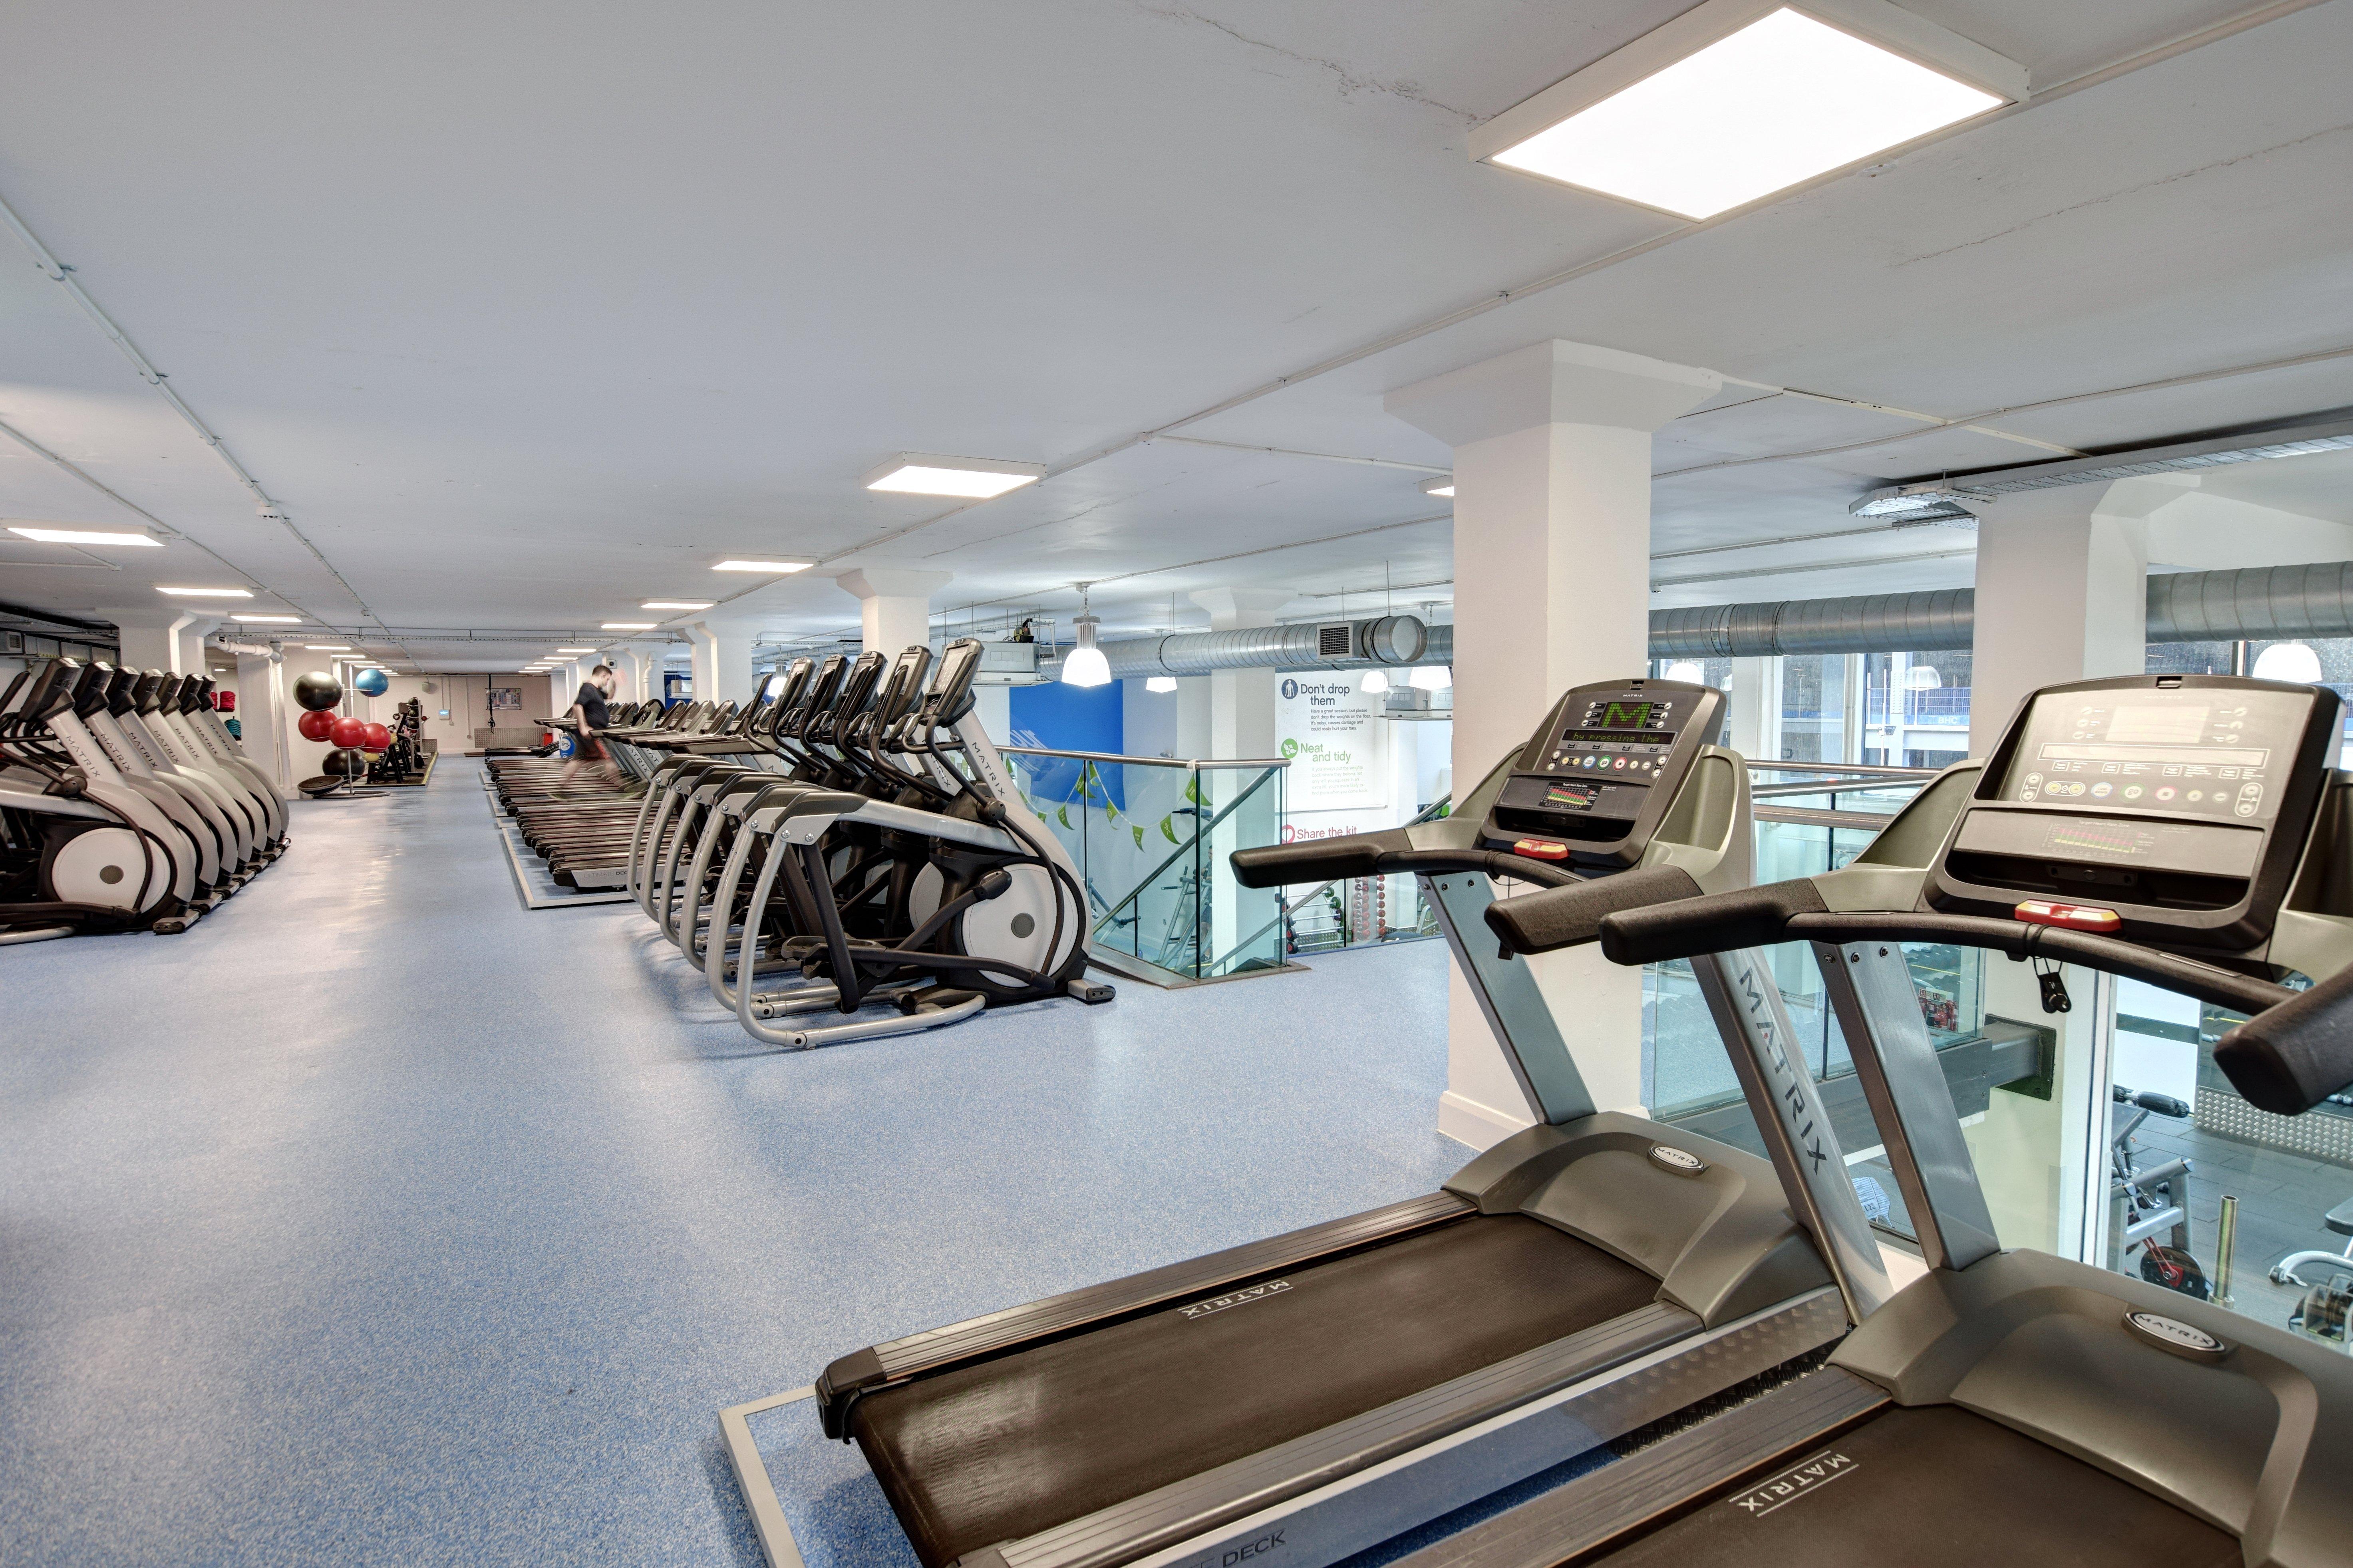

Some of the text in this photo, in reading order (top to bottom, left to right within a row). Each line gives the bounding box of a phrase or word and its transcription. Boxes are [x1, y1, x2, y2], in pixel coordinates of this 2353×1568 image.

[1301, 683, 1350, 697] Don't drop
[1310, 695, 1335, 705] them
[101, 733, 132, 771] MATRIX
[129, 732, 158, 767] MATRIX
[153, 730, 180, 763] MATRIX
[175, 728, 200, 758] MATRIX
[195, 726, 218, 754] MATRIX
[1301, 743, 1323, 753] Neat
[1572, 732, 1585, 740] by
[1641, 734, 1659, 743] the
[66, 736, 101, 777] MATRIX
[972, 742, 1005, 796] MATRIX
[1312, 750, 1351, 764] and tidy
[1297, 826, 1357, 839] Share the kit
[1739, 967, 1827, 1176] MATRIX
[1657, 1148, 1697, 1165] MATRIX
[1182, 1281, 1290, 1316] MATRIX
[2138, 1315, 2212, 1345] MATRIX
[1737, 1453, 1850, 1512] MATRIX
[1223, 1528, 1286, 1568] DECK
